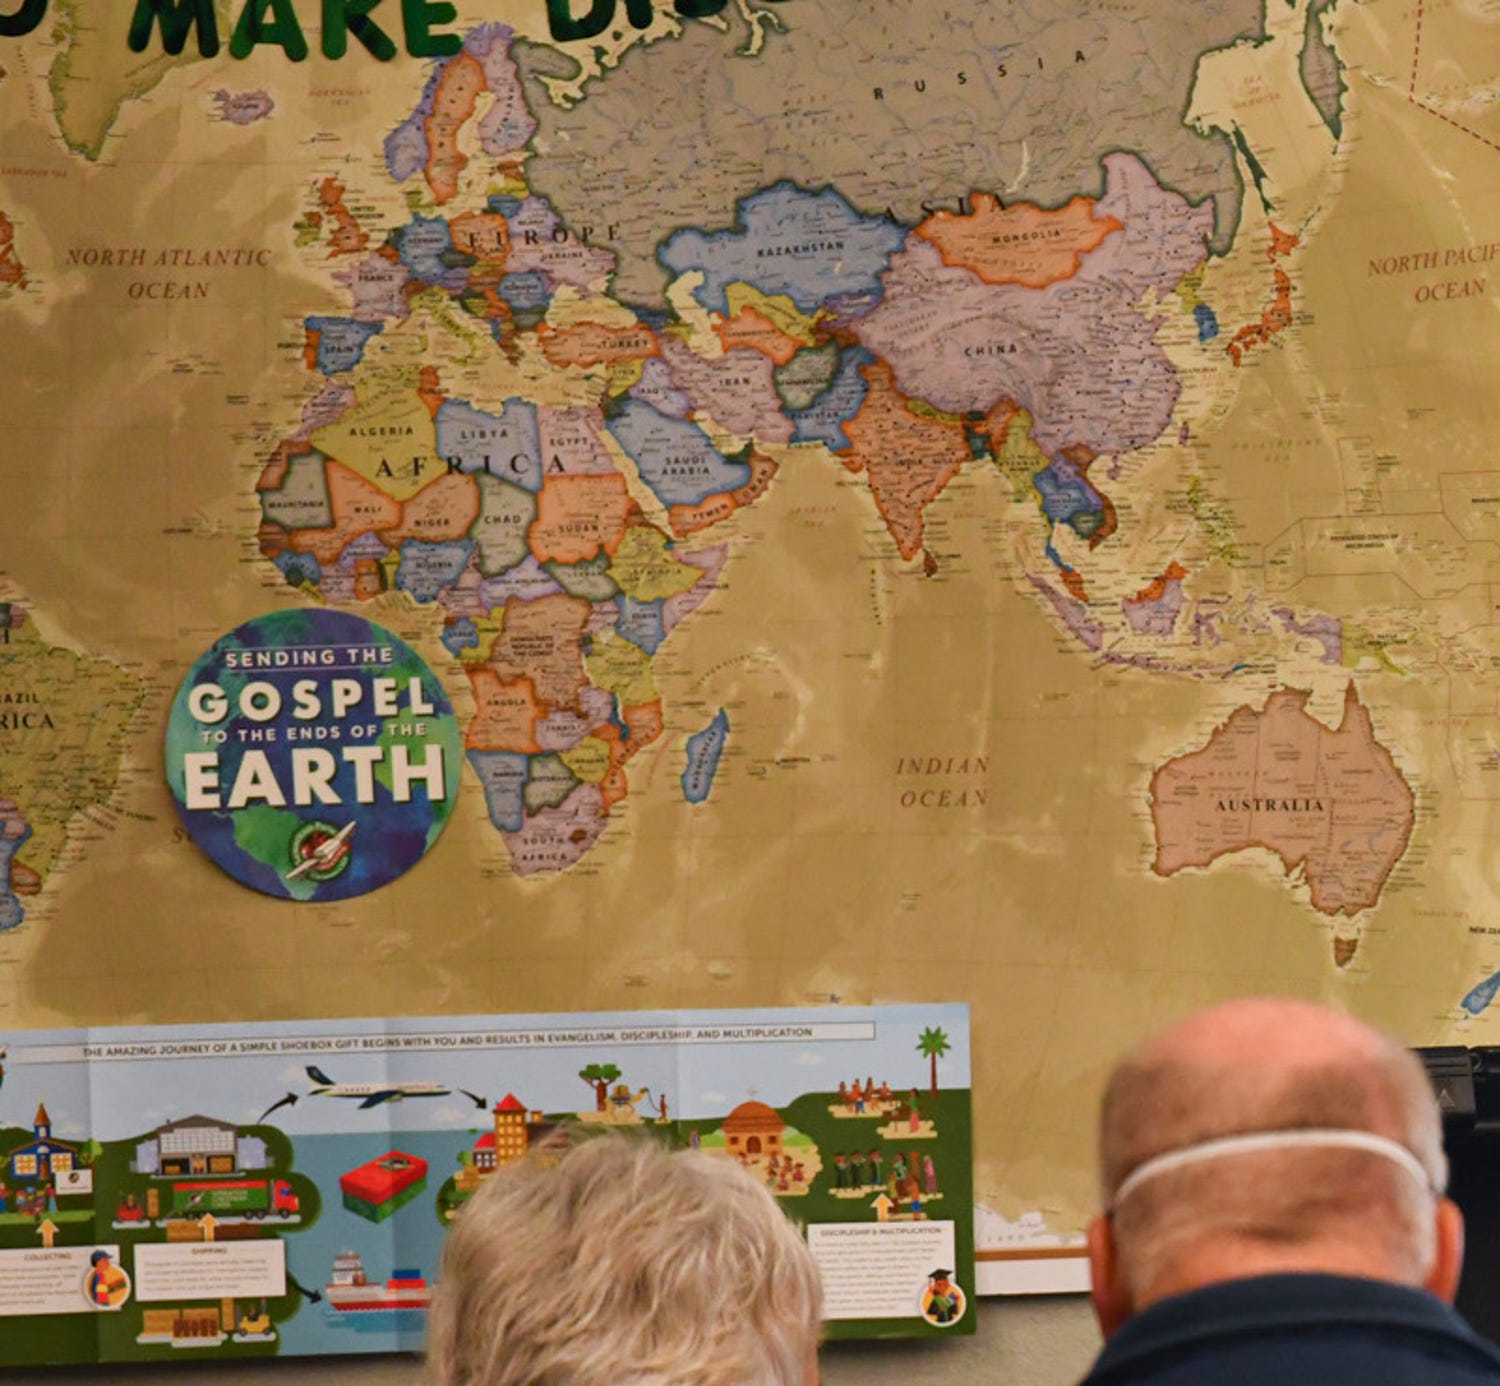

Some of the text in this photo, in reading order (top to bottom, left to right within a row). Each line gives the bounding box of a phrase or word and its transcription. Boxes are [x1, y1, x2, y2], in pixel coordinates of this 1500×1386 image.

[128, 0, 463, 62] MAKE
[872, 50, 1086, 100] RUSSIA
[469, 224, 622, 248] EUROPE
[992, 228, 1061, 244] MONGOLIA
[66, 248, 272, 267] NORTH ATLANTIC
[757, 241, 845, 258] KAZAKHSTAN
[1368, 252, 1437, 277] NORTH
[128, 282, 209, 299] OCEAN
[1414, 278, 1486, 303] OCEAN
[964, 343, 1017, 357] CHINA
[719, 376, 750, 385] IRAN
[349, 426, 413, 436] ALGERIA
[460, 429, 508, 439] LIBYA
[549, 436, 589, 446] EGYPT
[375, 453, 566, 477] AFRICA
[664, 455, 706, 465] SAUDI
[661, 466, 710, 476] ARABIA
[484, 514, 522, 525] CHAD
[692, 503, 728, 520] YEMEN
[559, 525, 598, 533] SUDAN
[226, 648, 393, 668] SENDING THE
[0, 692, 40, 704] AZIL
[188, 676, 434, 724] GOSPEL
[202, 723, 427, 743] TO THE ENDS OF THE
[896, 757, 990, 775] INDIAN
[184, 744, 446, 810] EARTH
[900, 790, 989, 808] OCEAN
[1216, 798, 1324, 812] AUSTRALIA
[83, 1047, 102, 1057] THE
[106, 1045, 156, 1056] AMAZING
[159, 1044, 210, 1055] JOURNEY
[212, 1043, 228, 1053] OF
[229, 1042, 238, 1052] A
[239, 1041, 277, 1052] SIMPLE
[280, 1040, 332, 1051] SHOEBOX
[334, 1039, 360, 1049] GIFT
[362, 1038, 401, 1049] BEGINS
[403, 1037, 431, 1047] WITH
[434, 1036, 456, 1046] YOU
[459, 1034, 482, 1045] AND
[485, 1033, 531, 1044] RESULTS
[533, 1032, 545, 1043] IN
[697, 1028, 720, 1039] AND
[723, 1026, 813, 1039] MULTIPLICATION
